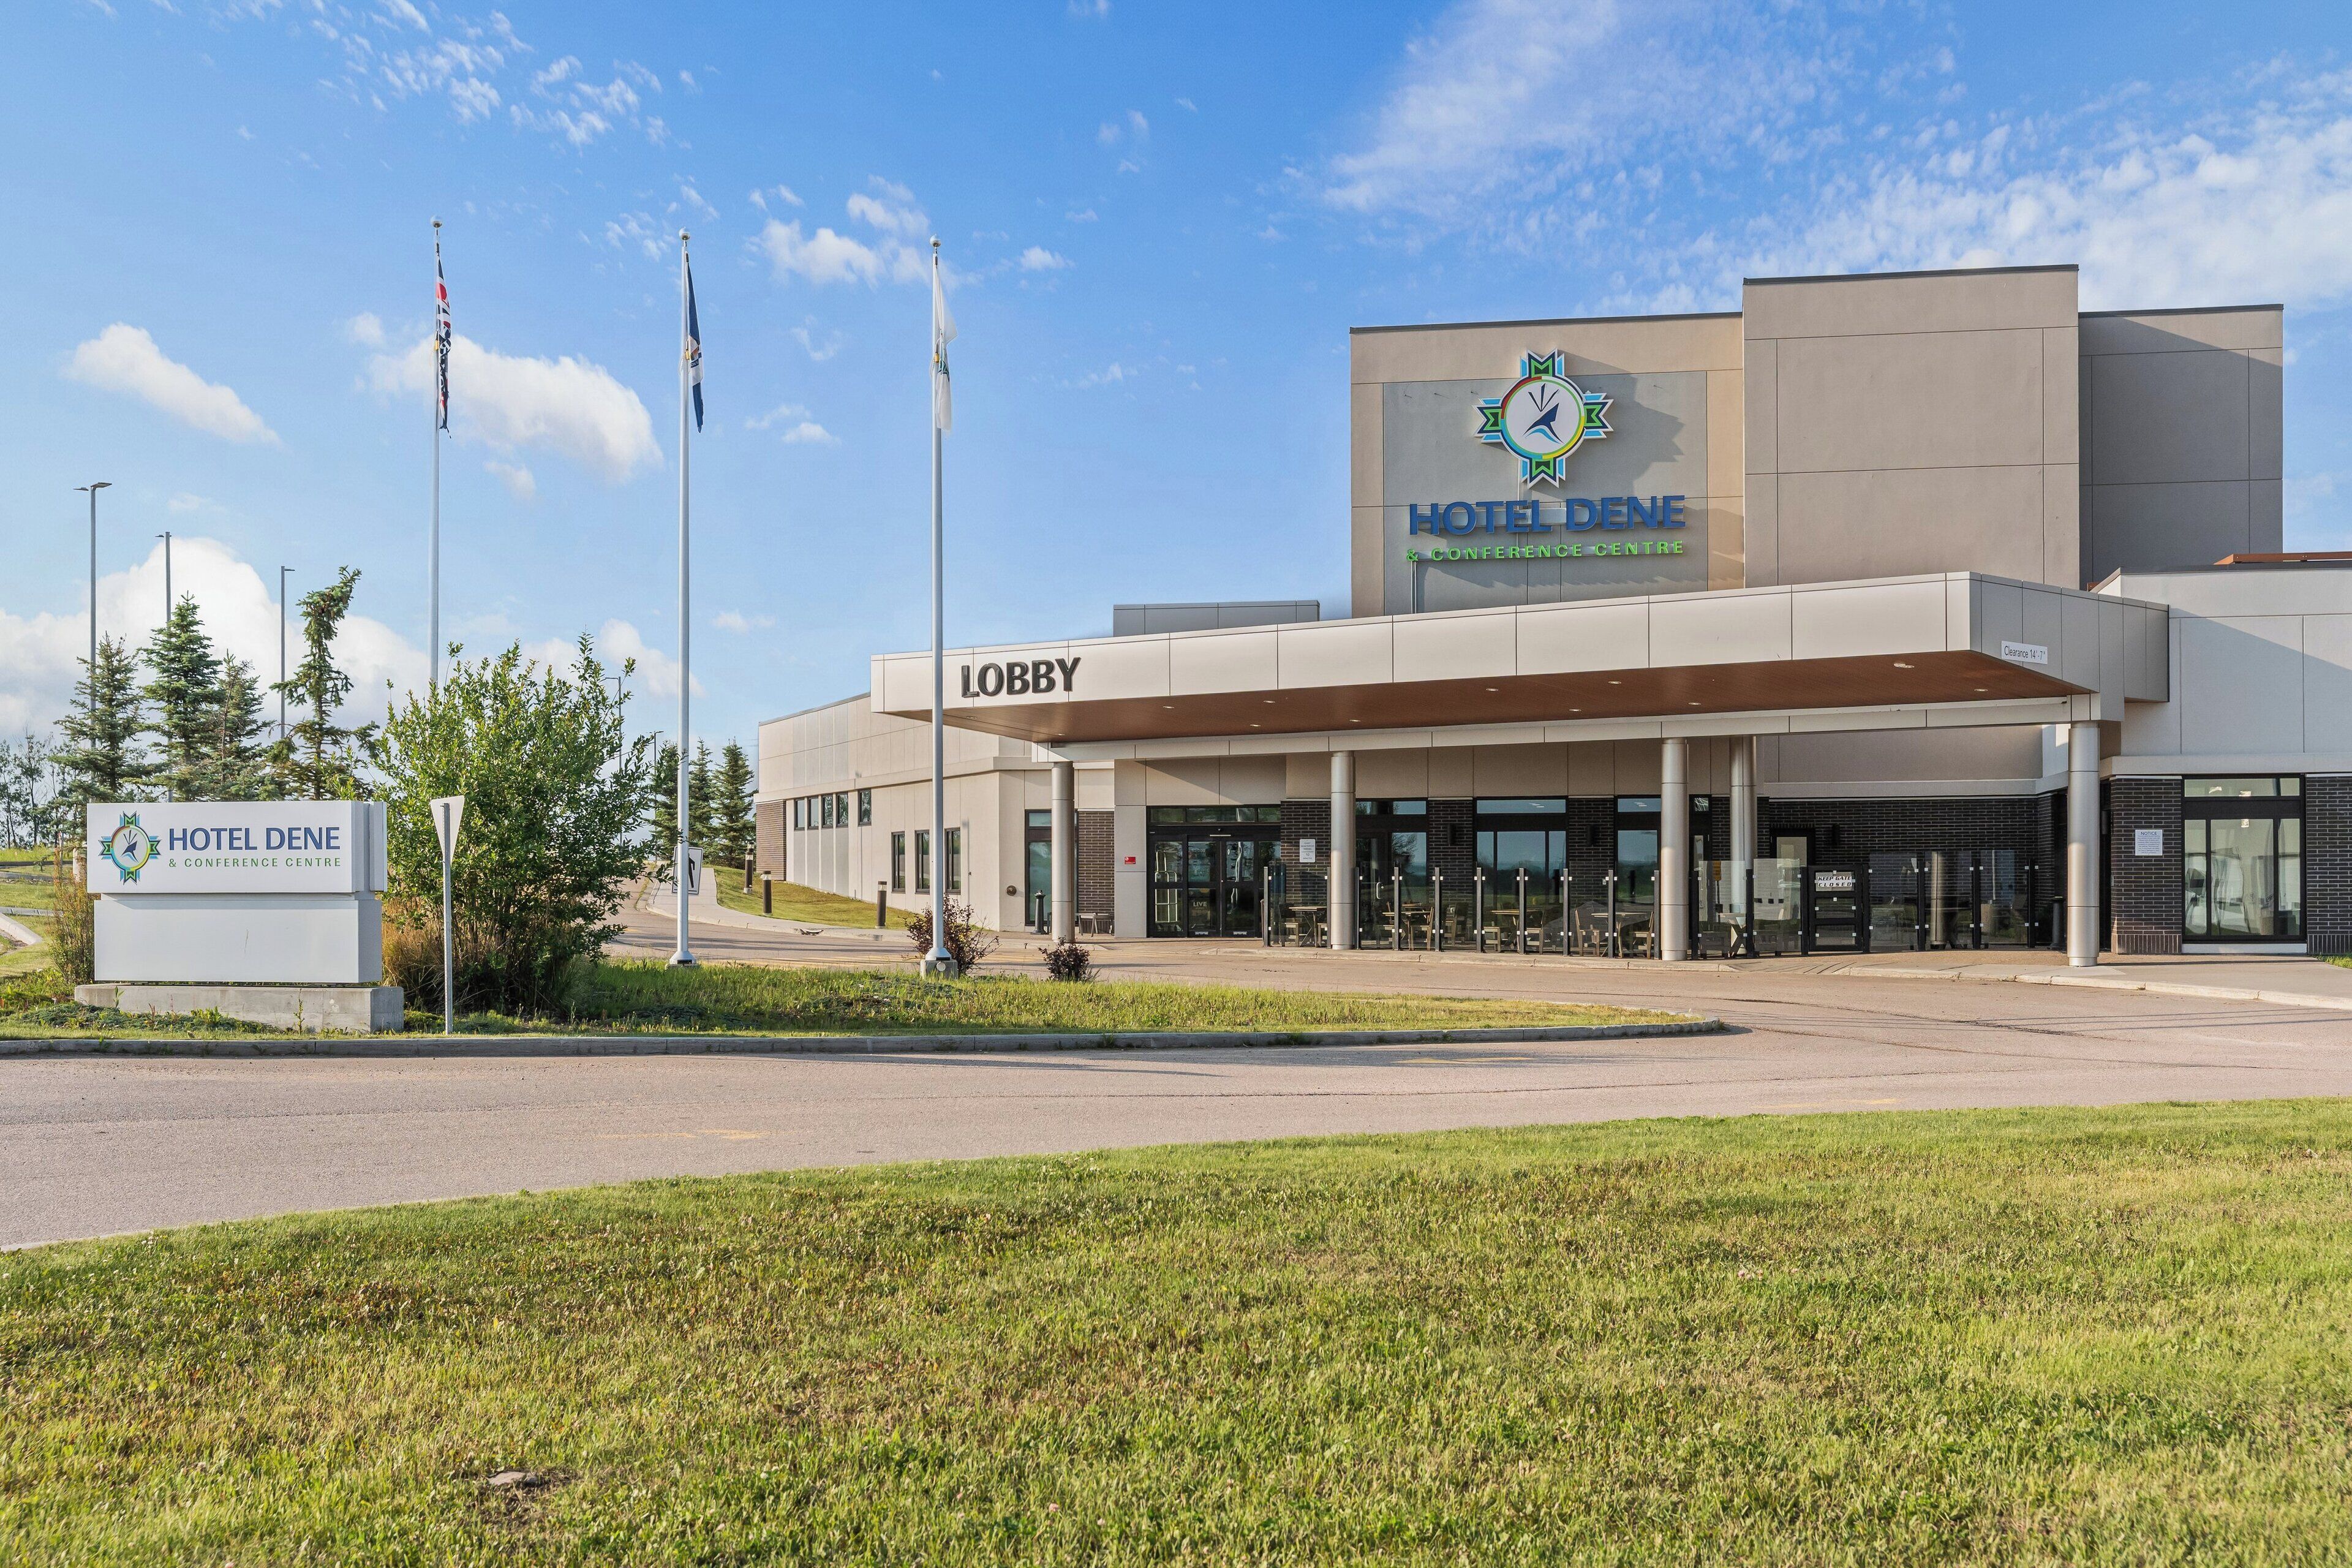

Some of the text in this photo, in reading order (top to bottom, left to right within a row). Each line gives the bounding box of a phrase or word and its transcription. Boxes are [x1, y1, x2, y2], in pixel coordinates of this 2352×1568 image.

[1409, 495, 1686, 535] HOTEL DENE
[1406, 540, 1683, 562] & CONFERENCE CENTRE
[2004, 646, 2029, 658] Clearance
[961, 657, 1082, 698] LOBBY
[169, 827, 341, 851] HOTEL DENE
[168, 858, 341, 867] & CONFERENCE CENTRE
